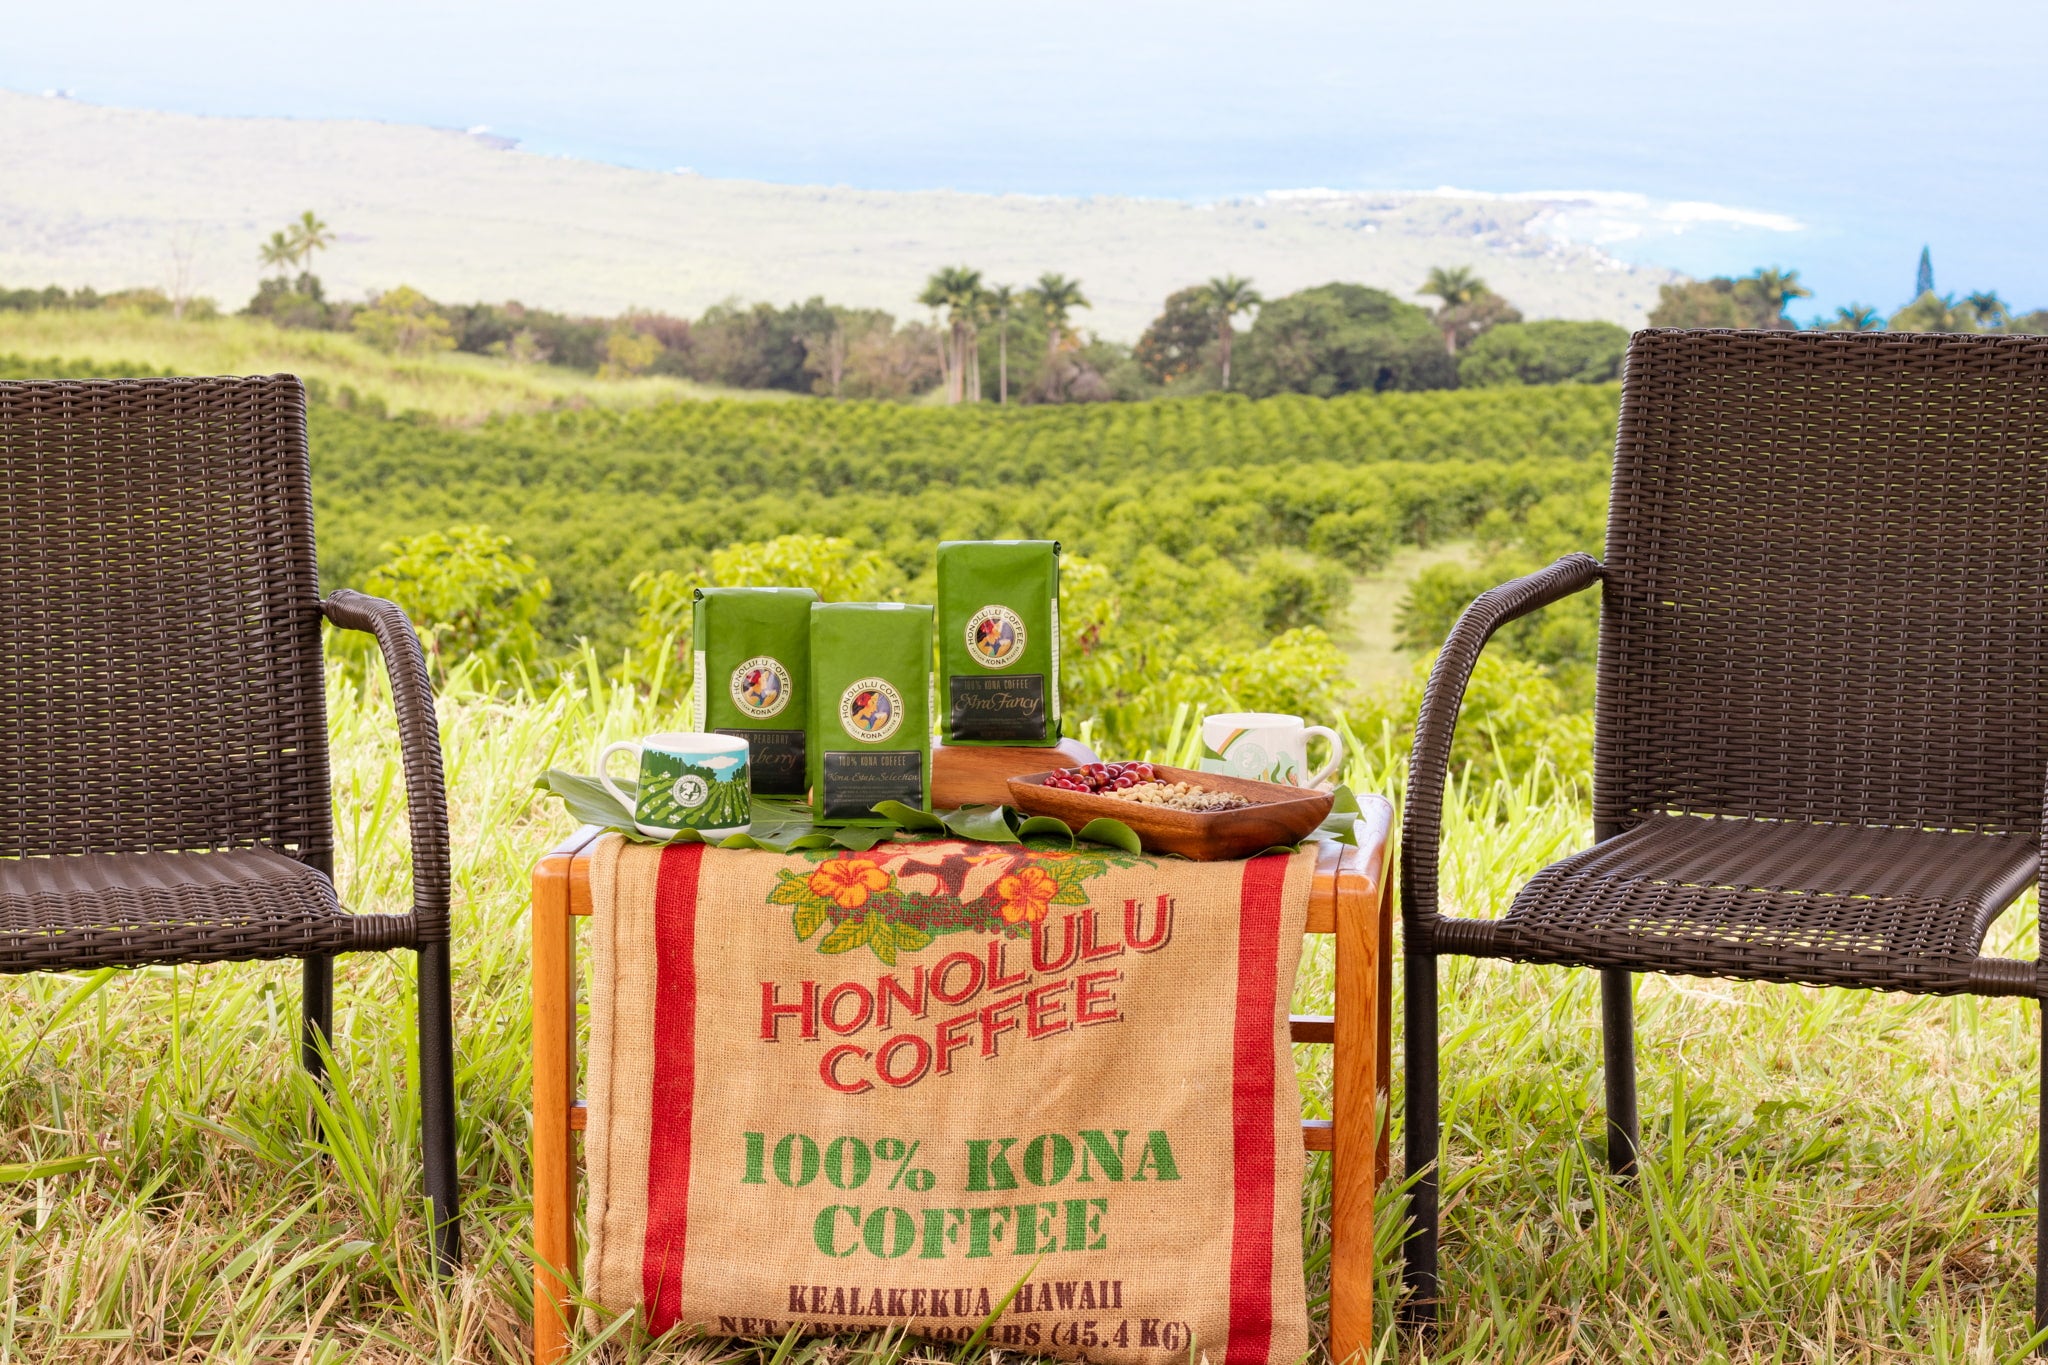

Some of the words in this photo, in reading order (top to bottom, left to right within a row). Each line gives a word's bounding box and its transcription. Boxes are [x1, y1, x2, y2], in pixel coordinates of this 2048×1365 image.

[967, 609, 1001, 645] HONOLULU
[1003, 611, 1023, 646] COFFEE
[733, 659, 768, 695] HONOLULU
[769, 662, 789, 696] COFFEE
[985, 658, 1007, 666] KONA
[842, 681, 878, 719] HONOLULU
[879, 683, 901, 719] COFFEE
[984, 679, 1001, 690] KONA
[1004, 679, 1029, 689] COFFEE
[750, 708, 772, 716] KONA
[753, 734, 789, 745] PEABERRY
[839, 755, 857, 767] 100%
[860, 755, 878, 767] KONA
[881, 755, 906, 767] COFFEE
[759, 894, 1176, 1043] HONOLULU
[819, 967, 1124, 1095] COFFEE
[740, 1131, 937, 1192] 100%
[965, 1129, 1182, 1192] KONA
[813, 1197, 1109, 1260] COFFEE
[788, 1284, 991, 1318] KEALAKEKUA
[1013, 1279, 1123, 1314] HAWAII
[718, 1316, 778, 1335] NET
[986, 1322, 1042, 1346] LBS
[1051, 1319, 1129, 1349] (45.4
[1140, 1318, 1192, 1351] KG)
